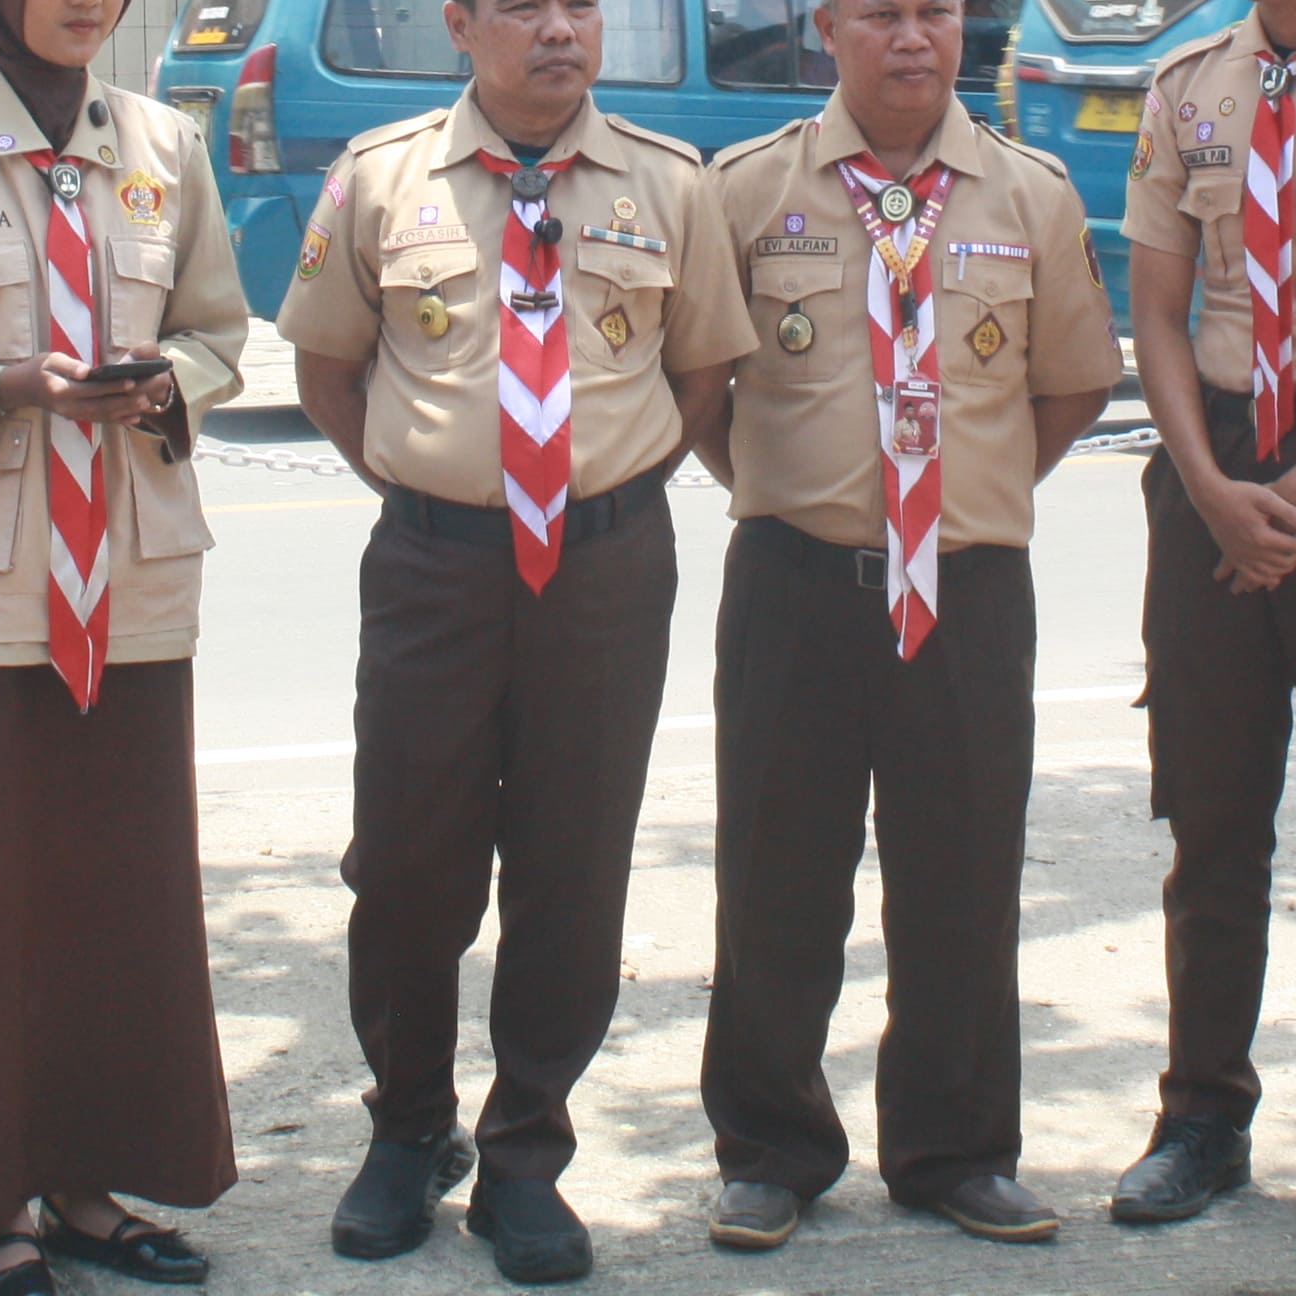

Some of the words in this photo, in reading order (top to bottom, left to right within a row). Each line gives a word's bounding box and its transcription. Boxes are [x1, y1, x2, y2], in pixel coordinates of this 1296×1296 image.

[395, 227, 460, 245] KOSASIH
[765, 239, 782, 252] EVI
[787, 239, 830, 251] ALFIAN
